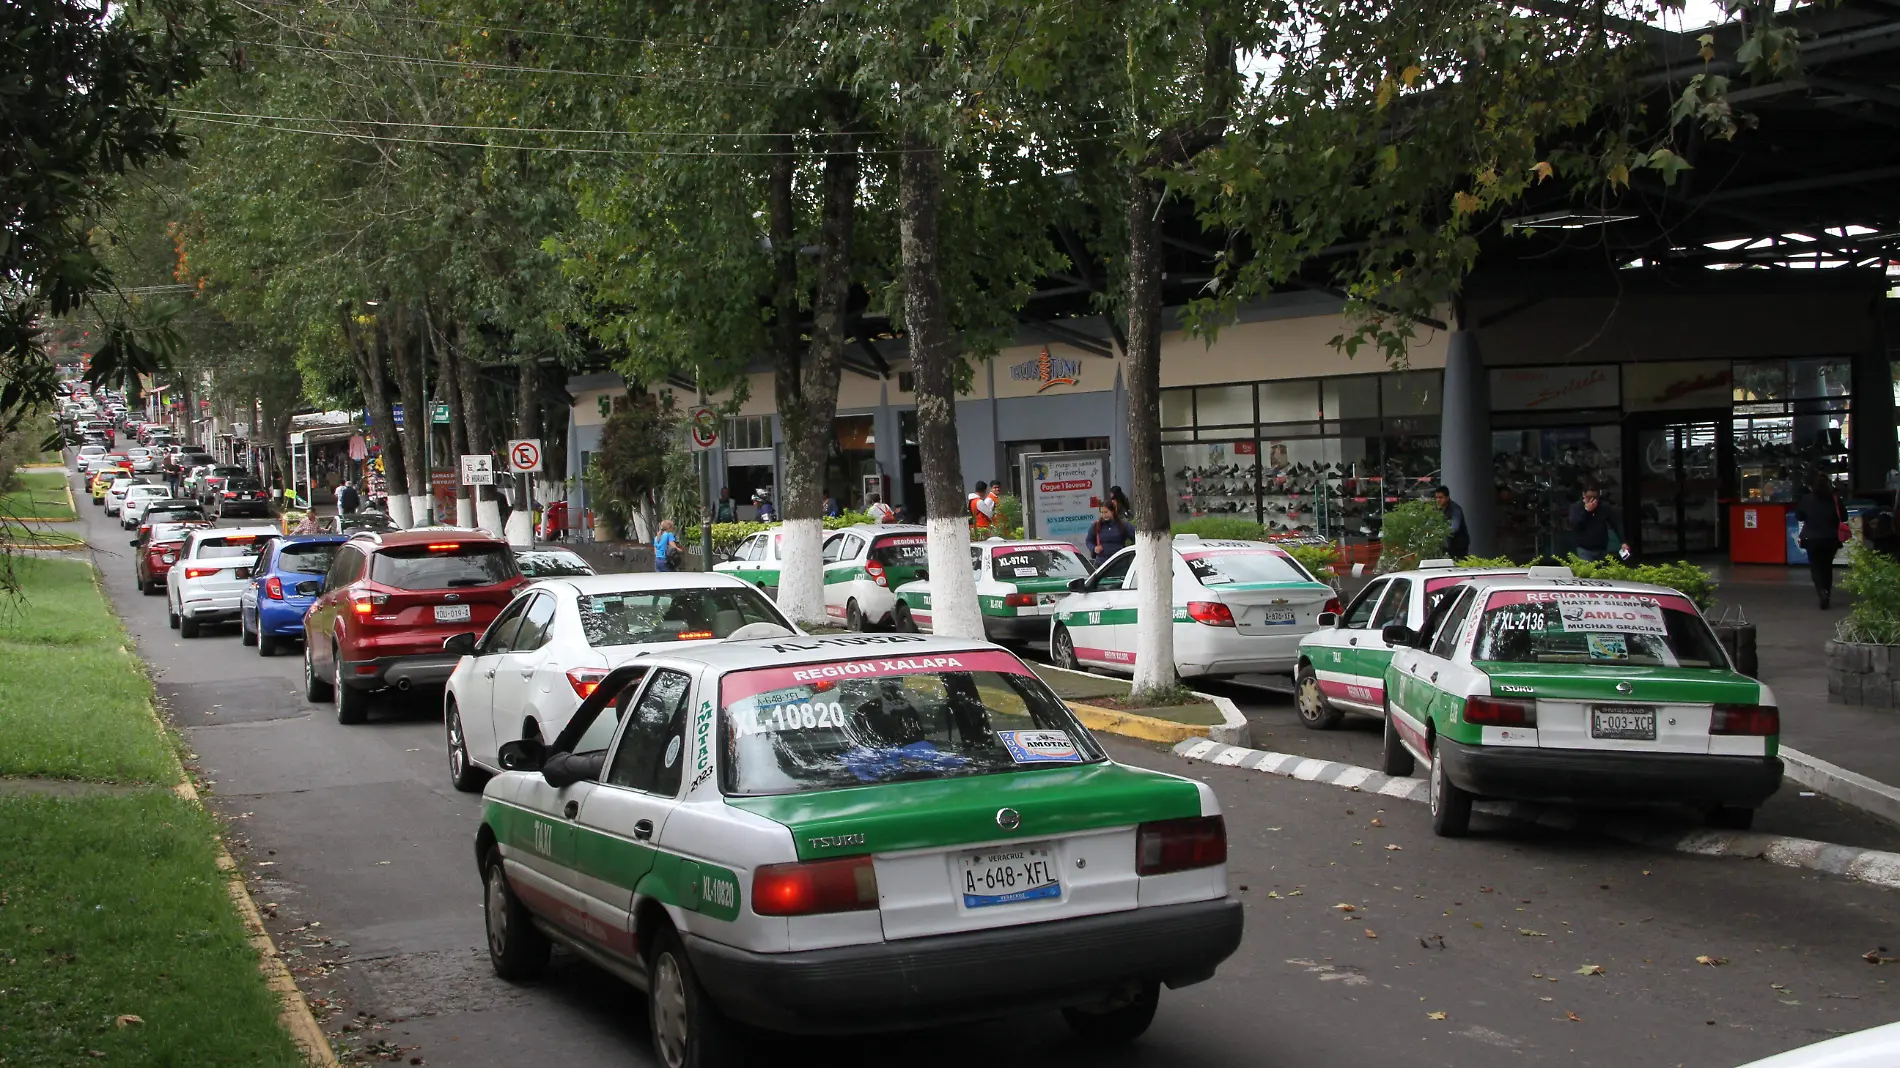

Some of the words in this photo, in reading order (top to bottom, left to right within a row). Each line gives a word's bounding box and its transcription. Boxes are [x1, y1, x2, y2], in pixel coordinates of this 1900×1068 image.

[998, 556, 1029, 567] XL-9747
[1088, 611, 1100, 624] TAXI
[1501, 612, 1544, 630] XL-2136
[1583, 611, 1636, 620] AMLO
[793, 662, 877, 681] REGIÓN
[882, 657, 963, 671] XALAPA
[733, 701, 845, 739] XL-10820
[1595, 716, 1653, 730] A-003-XCP
[697, 700, 713, 770] AMOTAC
[534, 819, 552, 857] TAXI
[808, 833, 865, 848] TSURU
[988, 852, 1024, 862] VERACRUZ
[966, 861, 1055, 892] A-648-XFL
[703, 875, 734, 908] XL-10820
